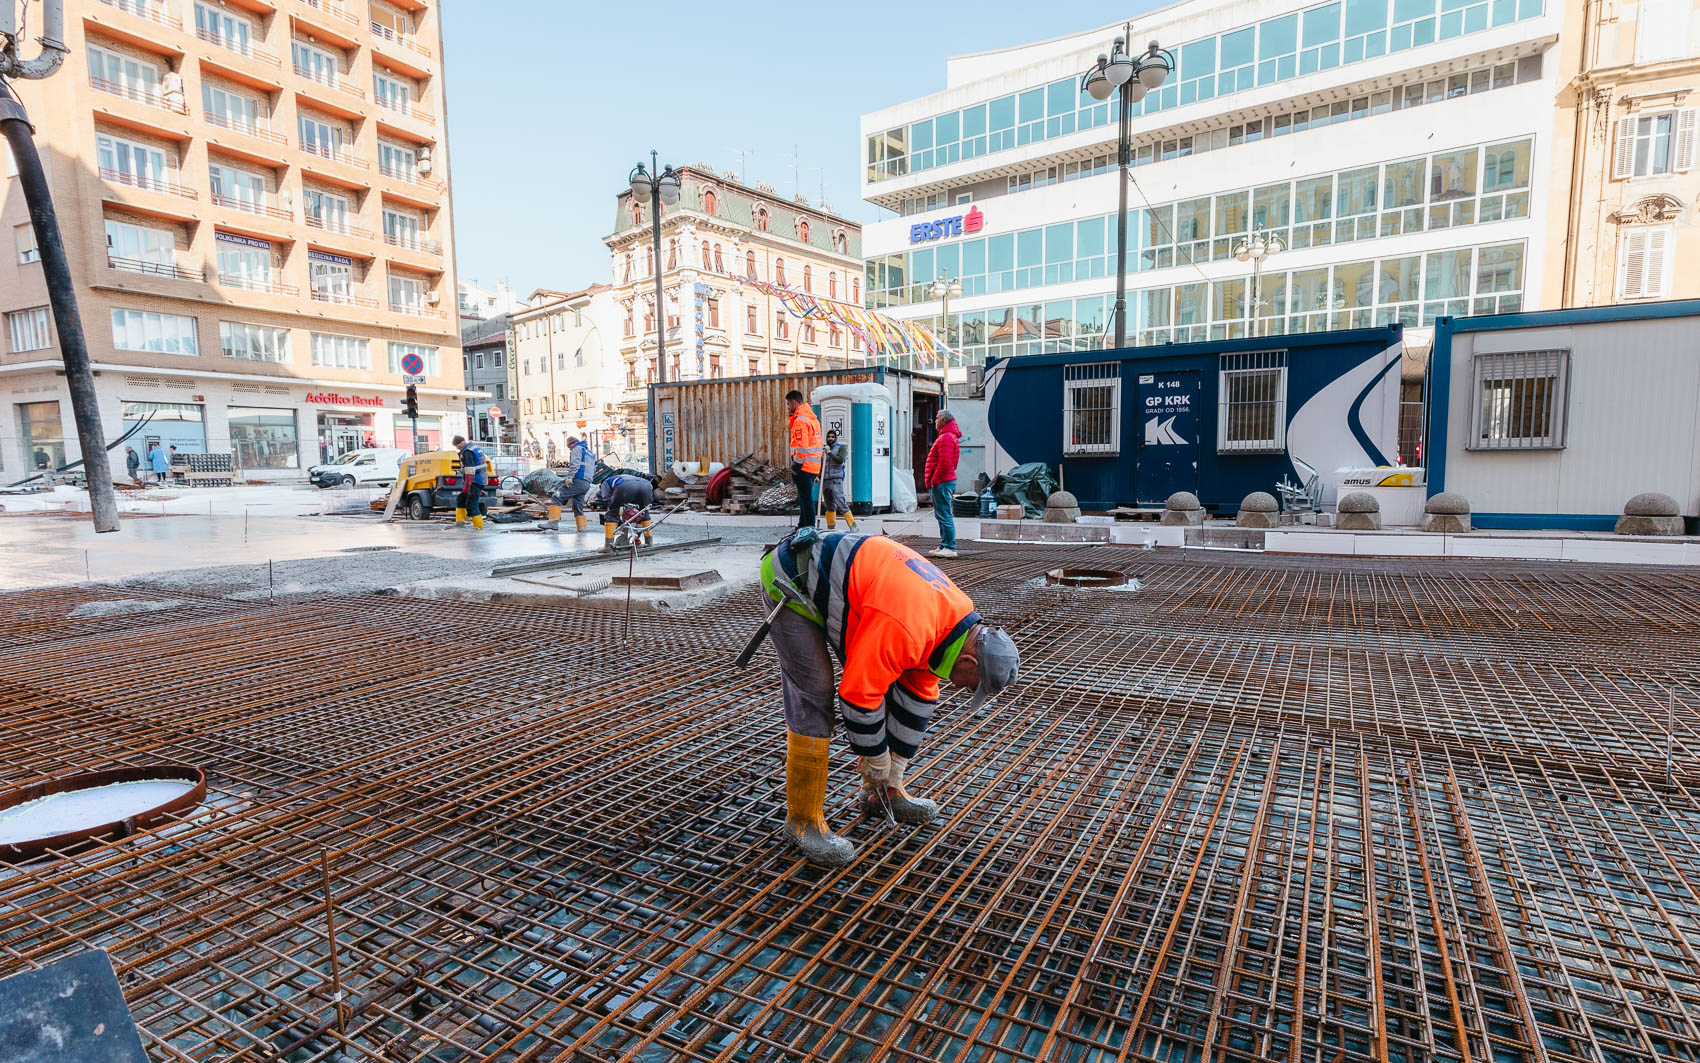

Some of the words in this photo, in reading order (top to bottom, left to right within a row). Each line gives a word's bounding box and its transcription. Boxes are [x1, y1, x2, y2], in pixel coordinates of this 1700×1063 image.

[911, 216, 963, 242] ERSTE
[215, 232, 247, 245] POLIKLINIKA
[335, 256, 349, 265] RADA
[1166, 380, 1180, 388] 148
[306, 392, 351, 405] Addiko
[352, 395, 384, 406] Bank
[1145, 396, 1162, 406] GP
[1165, 394, 1191, 405] KRK
[665, 429, 673, 443] GP
